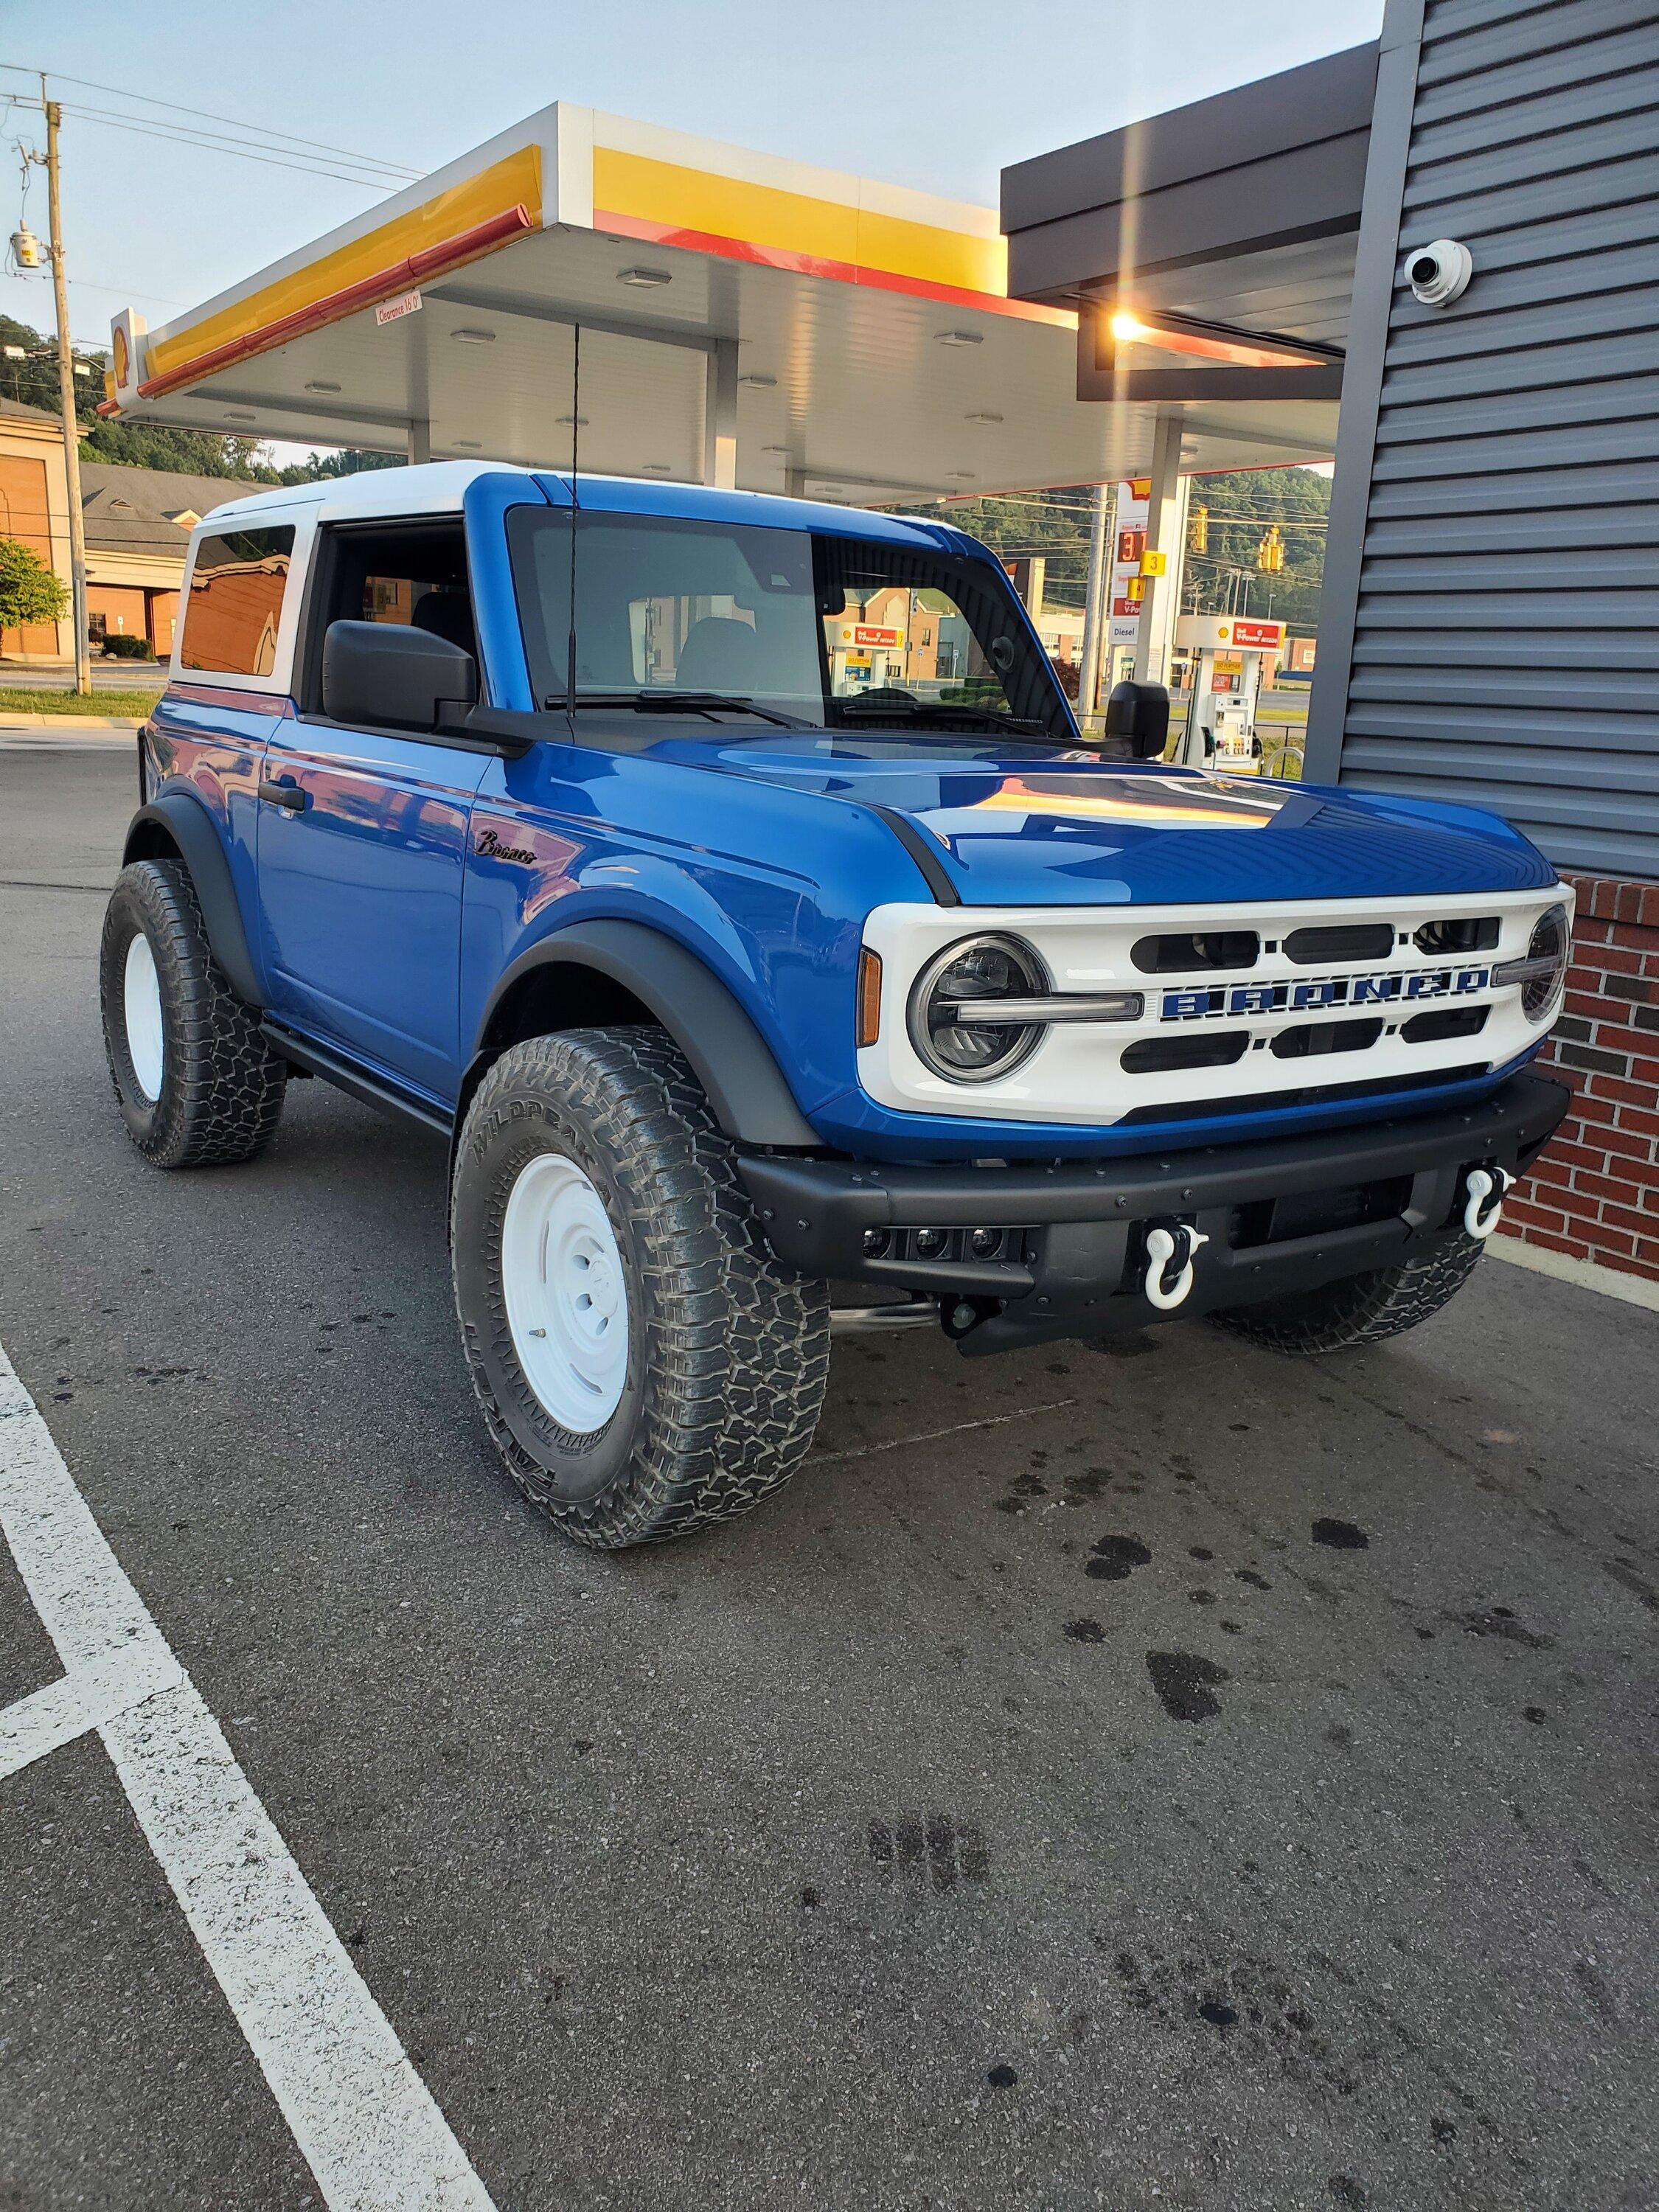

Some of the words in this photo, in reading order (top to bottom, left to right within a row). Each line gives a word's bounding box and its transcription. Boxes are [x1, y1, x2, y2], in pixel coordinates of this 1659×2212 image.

[379, 305, 405, 322] Clearance
[1150, 556, 1157, 570] 3
[1114, 627, 1135, 636] Diesel
[1237, 633, 1260, 643] V-Power
[473, 830, 538, 864] Bronco
[1162, 969, 1489, 1018] BRONCO
[468, 1099, 598, 1172] WILDPEAK
